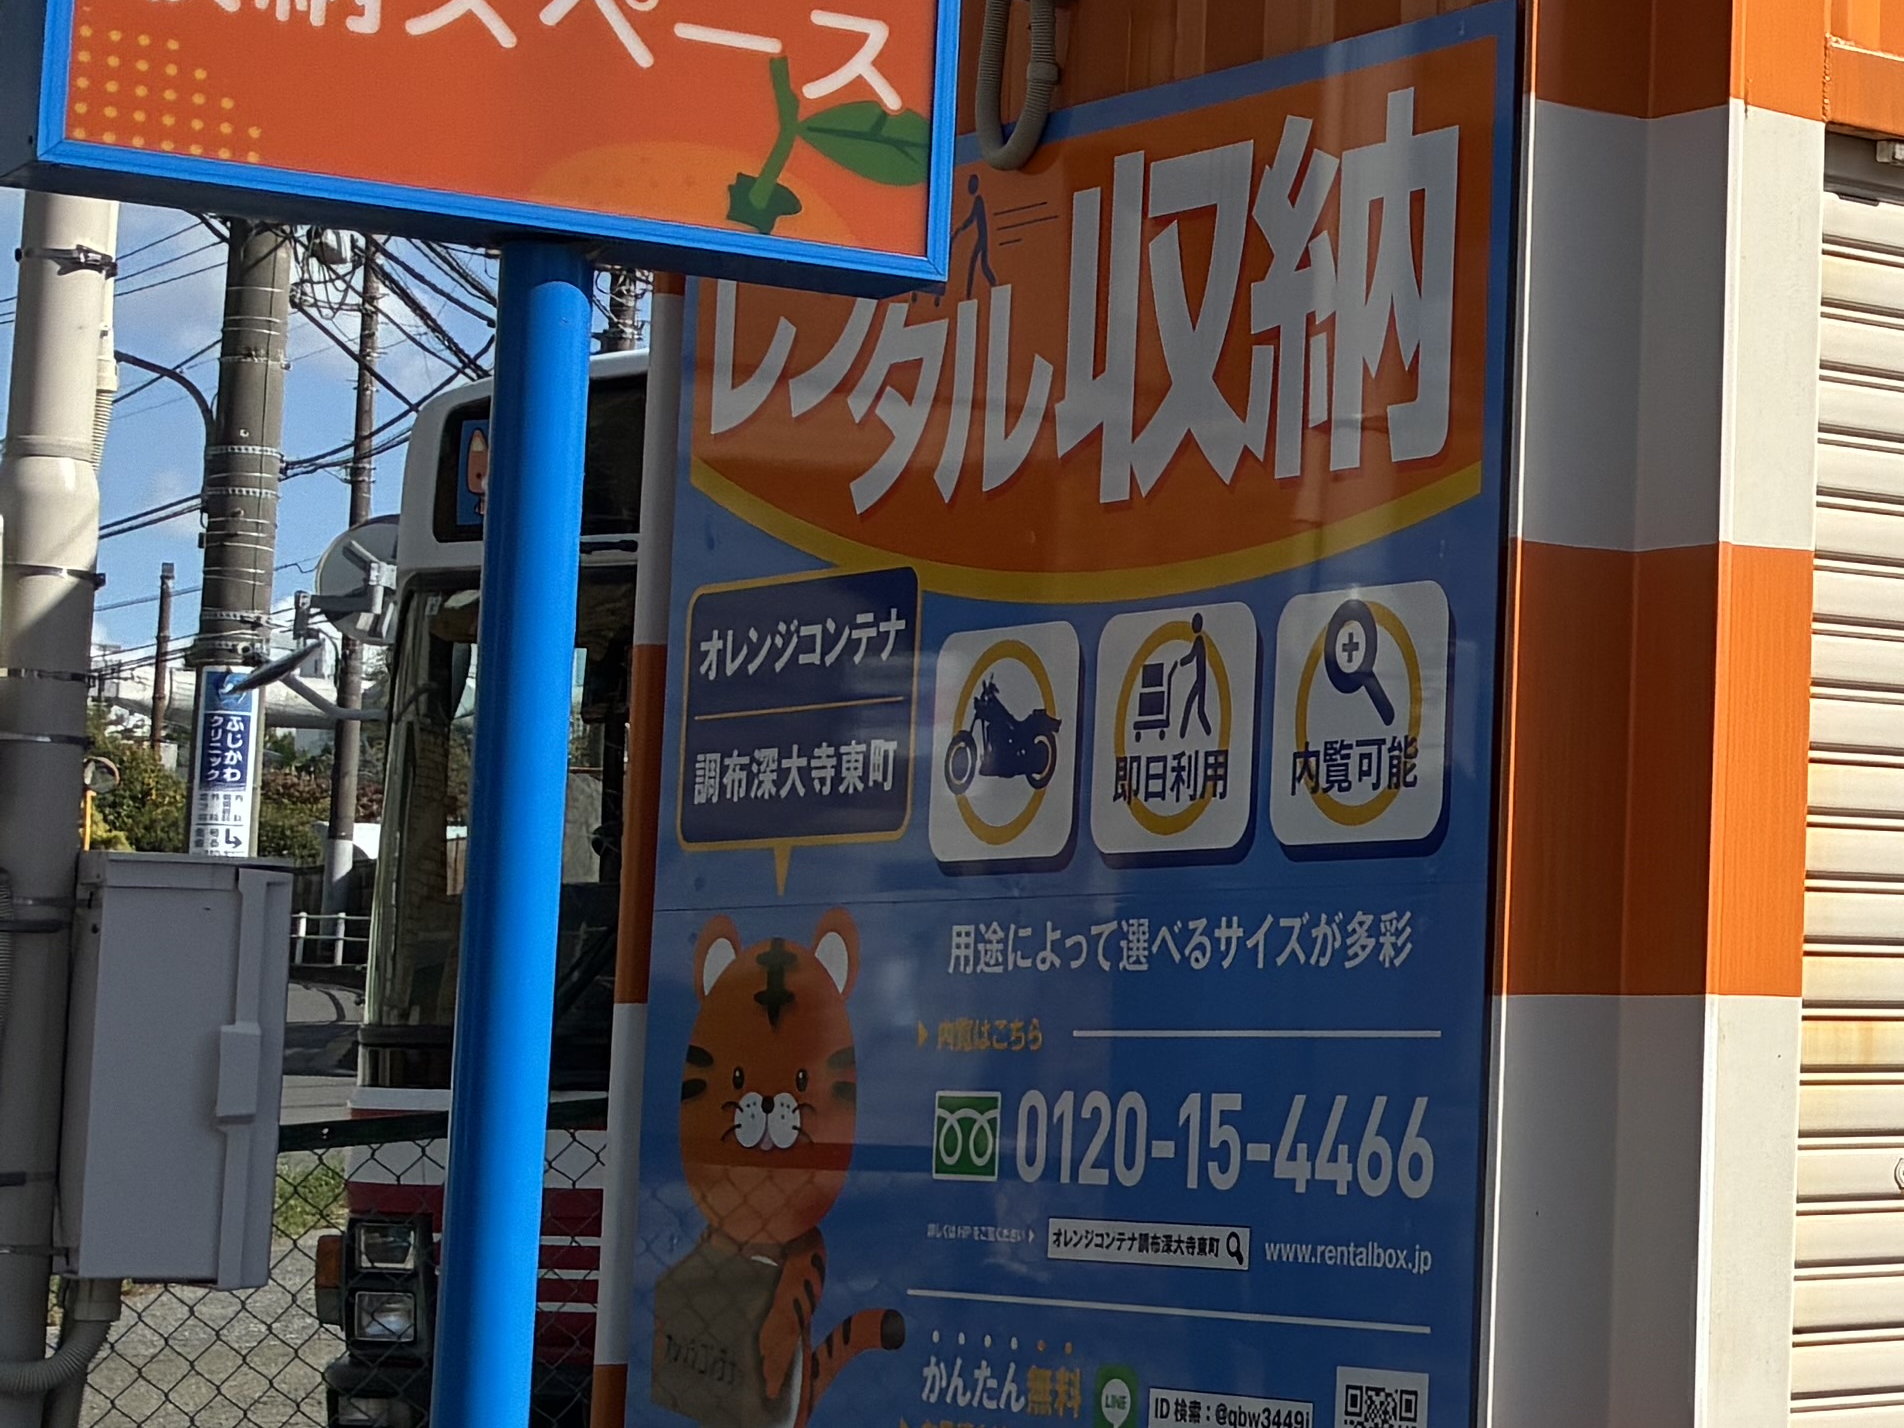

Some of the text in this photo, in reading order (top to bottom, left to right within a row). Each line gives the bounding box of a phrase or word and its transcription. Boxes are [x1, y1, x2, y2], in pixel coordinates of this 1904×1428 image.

[700, 607, 906, 681] オレンジコンテナ
[207, 715, 223, 782] クリニック
[222, 715, 245, 783] ふじかわ
[694, 738, 898, 805] 調布深大寺東町
[1112, 748, 1229, 805] 即日利用
[1291, 734, 1418, 797] 内覧可能
[948, 910, 1413, 975] 用途によって選べるサイズが多彩
[1016, 1089, 1435, 1199] 0120-15-4466
[1053, 1227, 1221, 1259] オレンジコンテナ調布深大寺東町
[1264, 1239, 1433, 1275] www.rentalbox.jp
[921, 1354, 1082, 1419] かんたん無料
[1105, 1393, 1128, 1410] LINE
